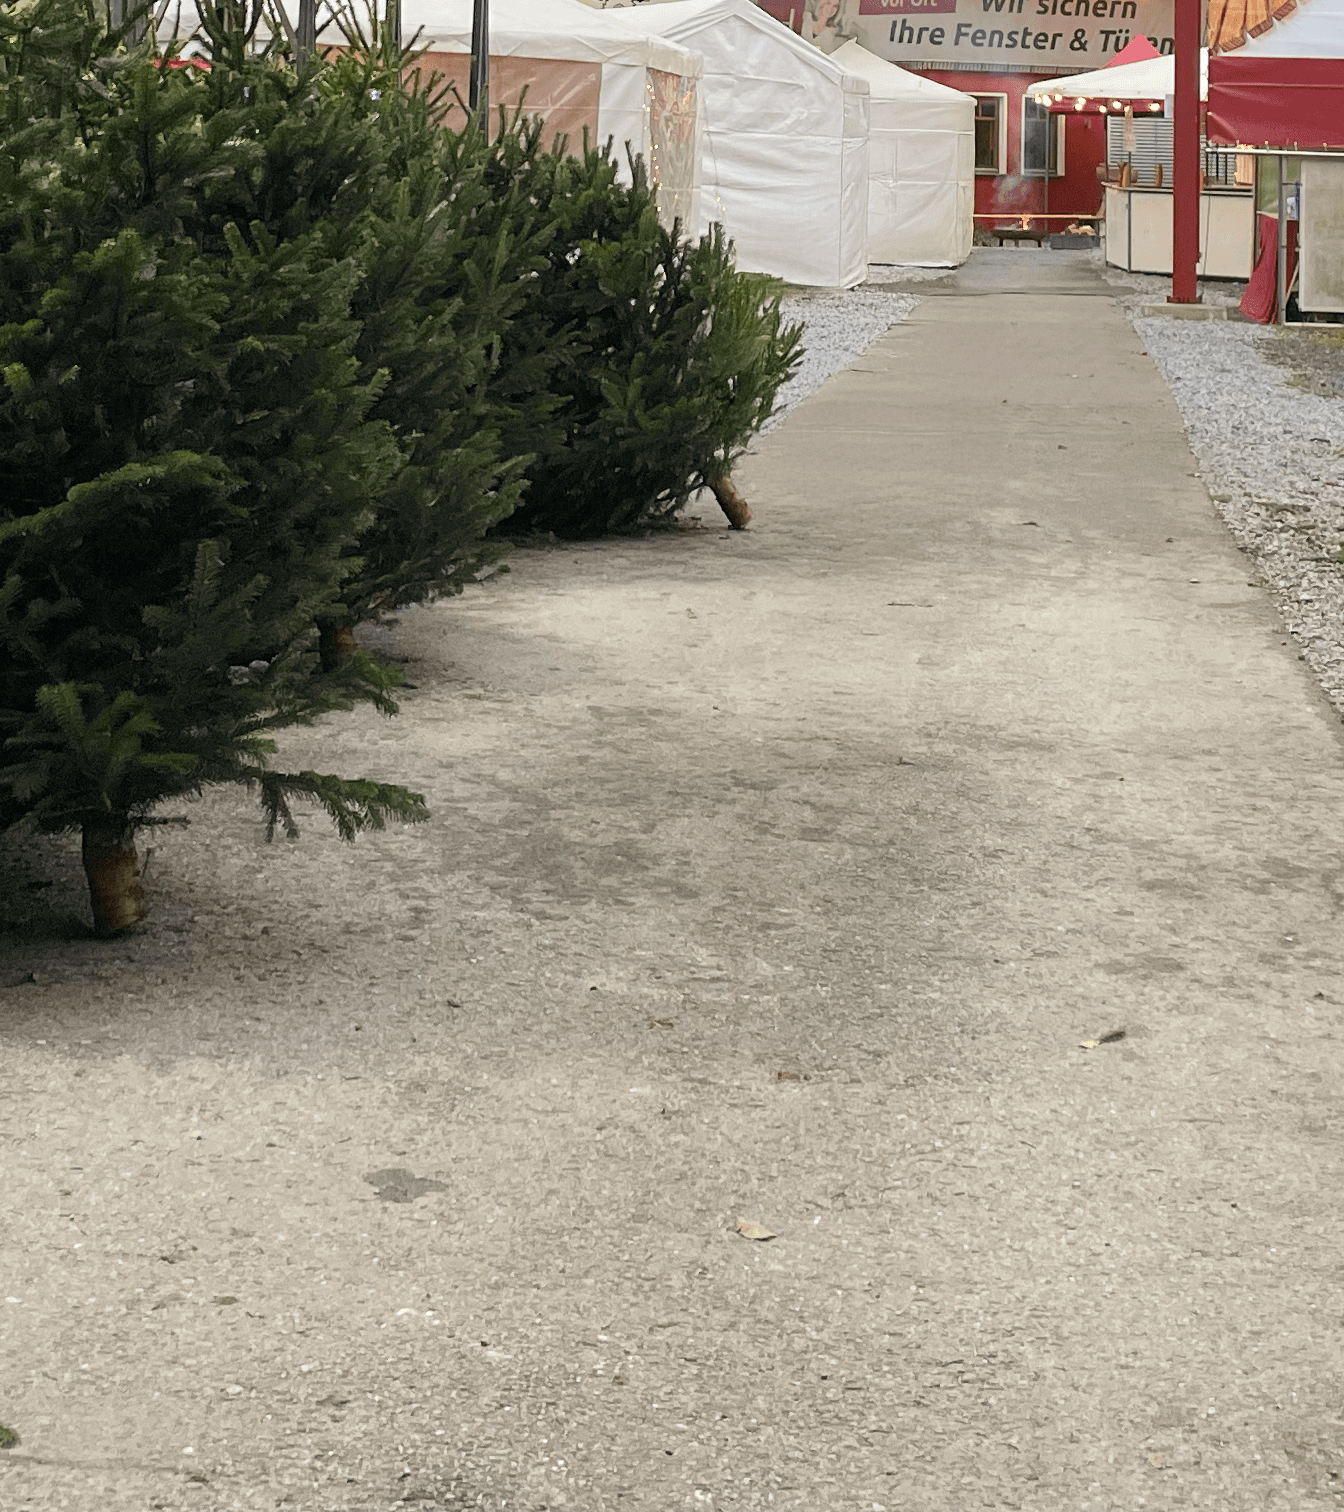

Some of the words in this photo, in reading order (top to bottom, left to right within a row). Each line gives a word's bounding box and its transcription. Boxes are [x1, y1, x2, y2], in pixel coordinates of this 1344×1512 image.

[889, 18, 946, 46] Ihre
[953, 23, 1063, 51] Fenster
[1069, 28, 1089, 52] &
[1099, 29, 1175, 55] Tün
